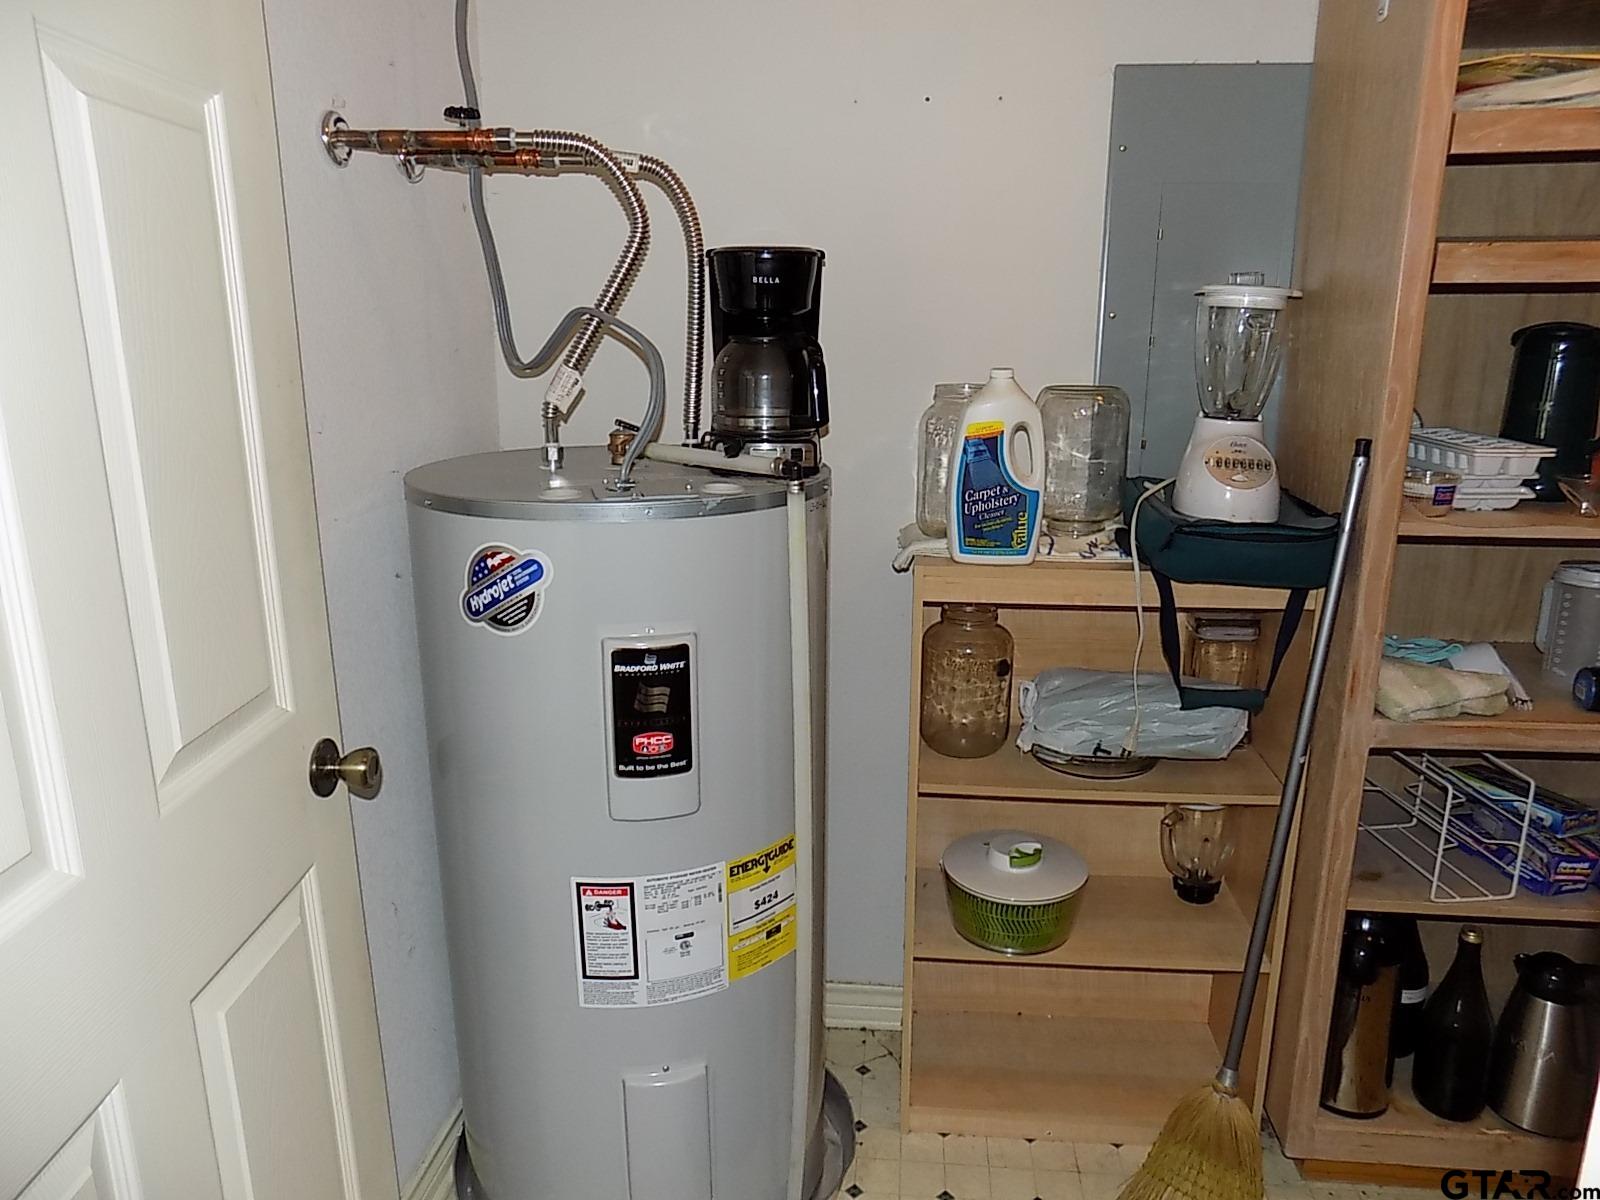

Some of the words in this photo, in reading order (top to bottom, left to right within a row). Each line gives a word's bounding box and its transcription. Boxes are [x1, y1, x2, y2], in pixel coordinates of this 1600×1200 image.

[752, 276, 780, 284] BELLA
[965, 486, 1000, 502] Carpet
[964, 494, 1018, 516] Upholstery
[979, 510, 1005, 521] Cleaner
[469, 574, 516, 613] Hydrojet
[613, 664, 658, 673] BRADFORD
[660, 661, 686, 671] WHITE
[635, 736, 672, 746] PHCC
[618, 764, 634, 772] Built
[636, 763, 644, 771] to
[645, 763, 656, 771] be
[657, 762, 669, 770] the
[670, 760, 687, 769] Best
